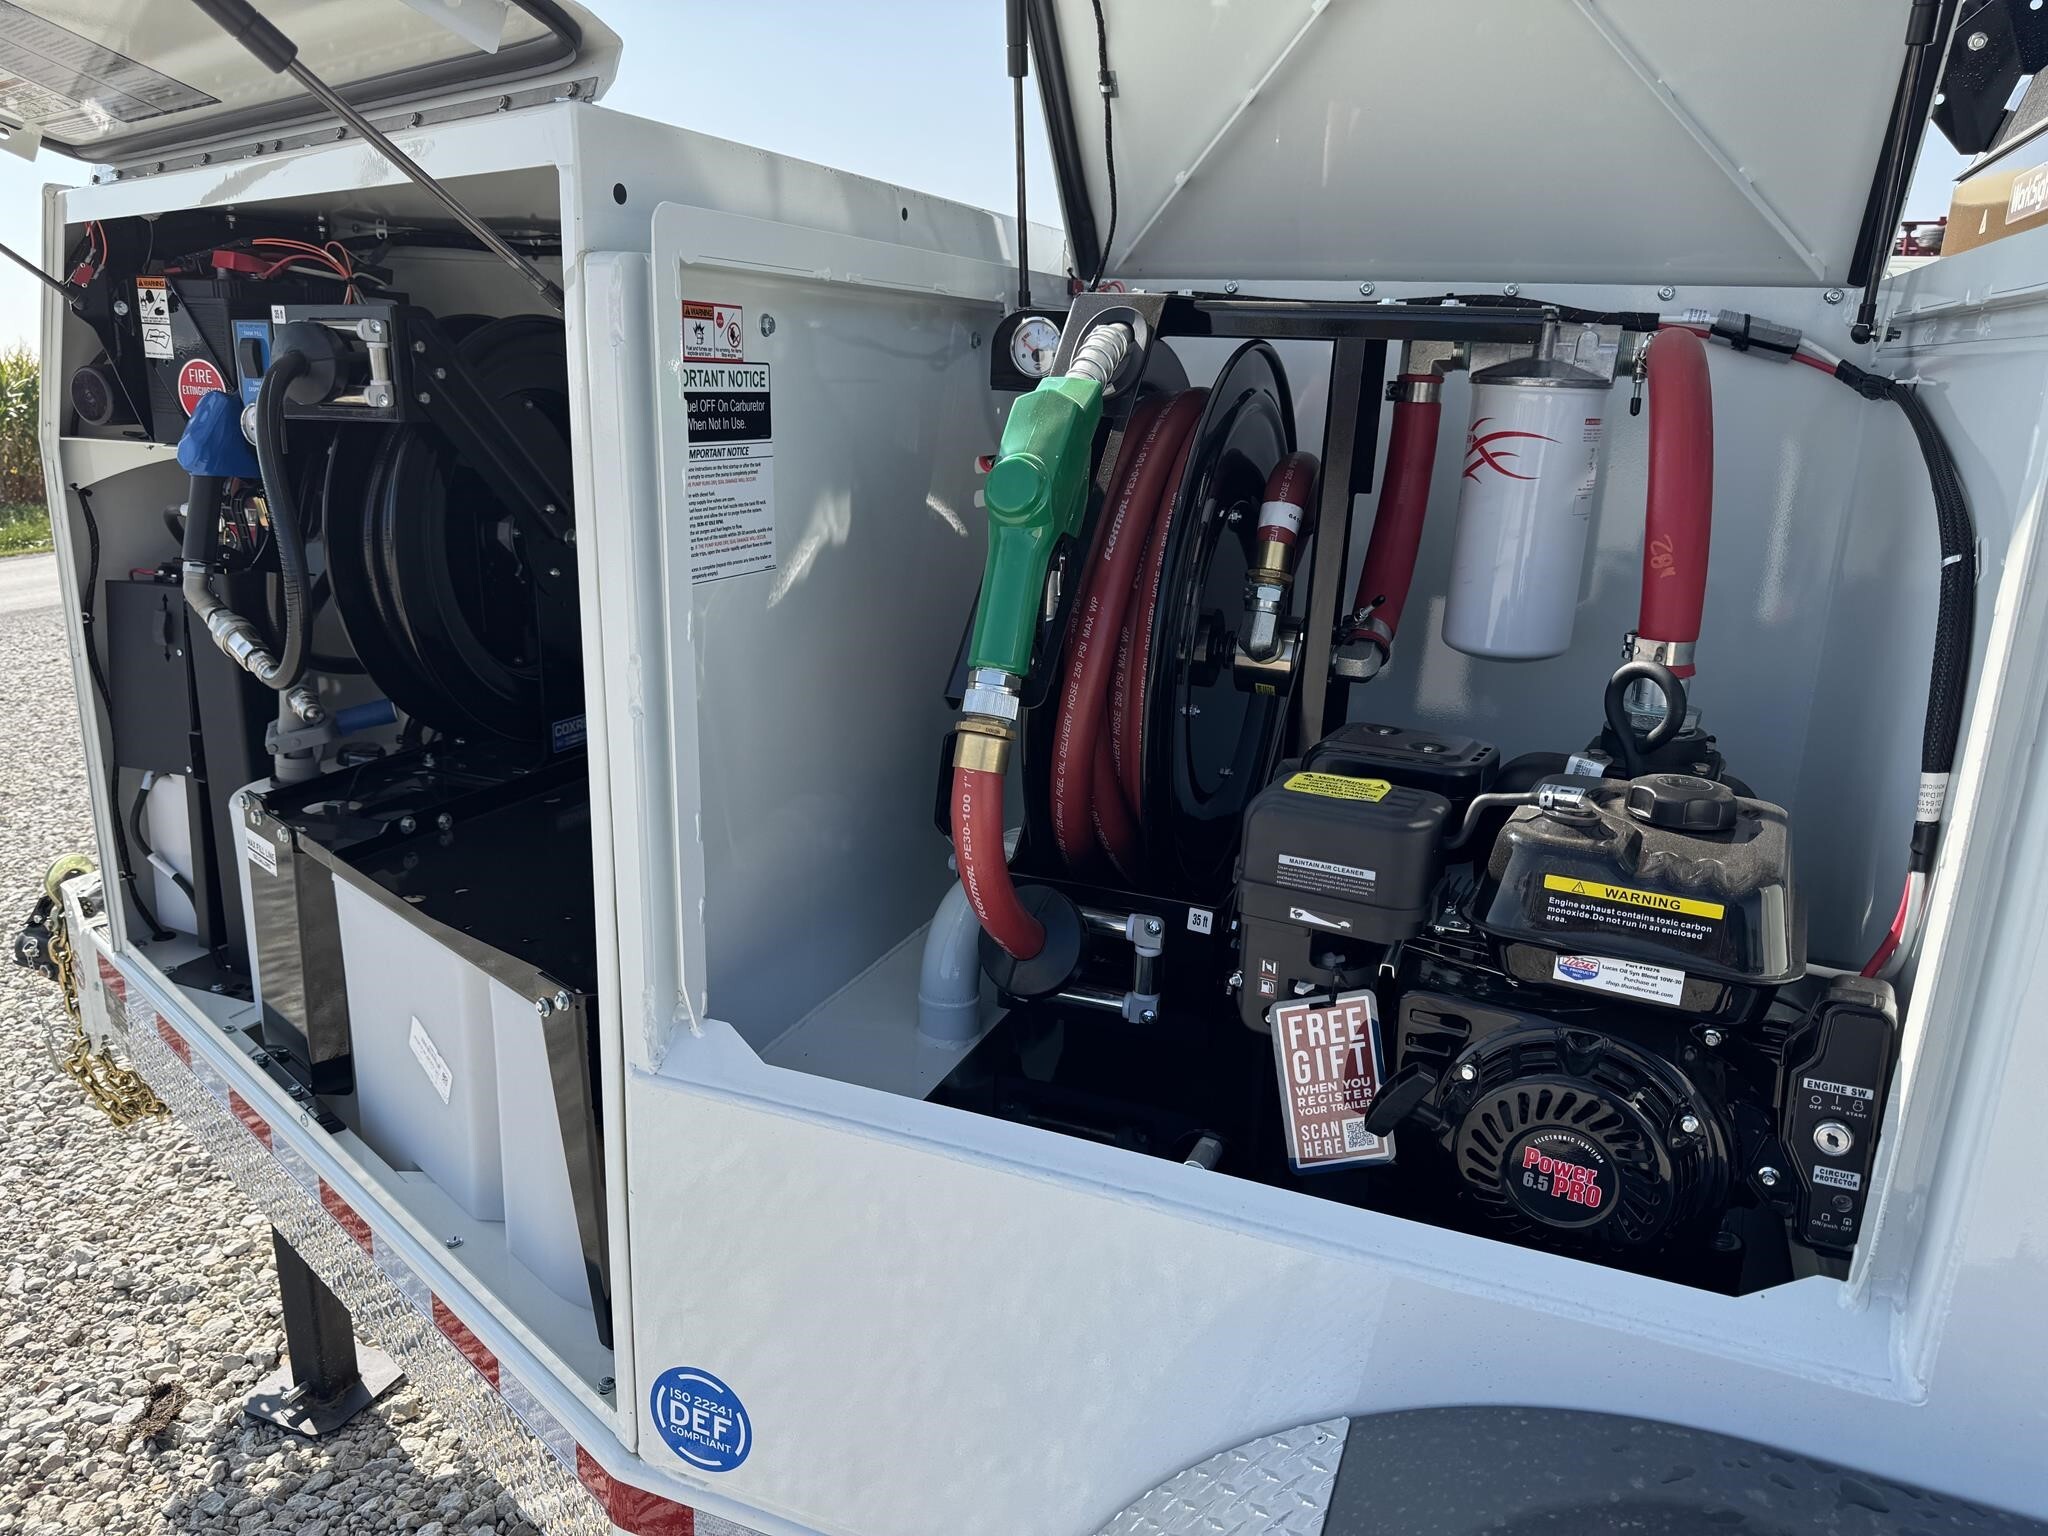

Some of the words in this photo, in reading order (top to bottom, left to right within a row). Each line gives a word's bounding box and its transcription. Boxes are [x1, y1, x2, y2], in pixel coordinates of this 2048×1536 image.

[144, 279, 165, 288] WARNING
[189, 368, 213, 384] FIRE
[684, 369, 725, 388] ORTANT
[728, 370, 766, 388] NOTICE
[688, 400, 698, 412] uel
[700, 400, 716, 412] OFF
[717, 400, 729, 412] On
[730, 400, 766, 412] Carburetor
[708, 417, 722, 430] Not
[723, 417, 730, 430] In
[731, 417, 747, 430] Use.
[689, 448, 726, 459] MPORTANT
[727, 446, 750, 457] NOTICE
[1089, 595, 1100, 613] WP
[1082, 615, 1095, 640] MAX
[1121, 625, 1130, 643] WP
[1077, 640, 1088, 659] PSI
[1118, 644, 1128, 669] MAX
[1073, 659, 1083, 679] 250
[1067, 680, 1079, 710] HOSE
[1112, 703, 1121, 734] HOSE
[1060, 712, 1073, 758] DELIVERY
[1057, 760, 1067, 776] OIL
[1055, 777, 1065, 798] FUEL
[1319, 775, 1372, 787] WARNING
[963, 794, 972, 860] PE30-100
[1288, 858, 1319, 869] MAINTAIN
[1320, 864, 1332, 872] AIR
[1332, 866, 1365, 877] CLEANER
[1604, 887, 1681, 911] WARNING
[1192, 913, 1201, 926] 35
[1202, 915, 1209, 928] ft
[1546, 914, 1568, 924] area.
[1548, 897, 1579, 909] Engine
[1580, 903, 1615, 916] exhaust
[1616, 909, 1655, 922] contains
[1656, 916, 1679, 927] toxic
[1680, 920, 1713, 933] carbon
[1606, 917, 1621, 926] not
[1621, 920, 1637, 929] run
[1638, 921, 1647, 929] in
[1648, 924, 1660, 932] an
[1661, 926, 1703, 940] enclosed
[1563, 956, 1597, 970] LUCAS
[1602, 964, 1618, 972] Lucas
[1641, 972, 1659, 980] Blend
[1625, 962, 1638, 970] Part
[1605, 980, 1674, 998] shop.thundercreek.com
[1624, 977, 1650, 987] Purchase
[1288, 1006, 1365, 1050] FREE
[1292, 1042, 1366, 1084] GIFT
[1295, 1080, 1338, 1096] WHEN
[1342, 1076, 1371, 1090] YOU
[1807, 1080, 1847, 1094] ENGINE
[1297, 1088, 1373, 1107] REGISTER
[1298, 1105, 1328, 1117] YOUR
[1845, 1111, 1867, 1119] START
[1301, 1120, 1341, 1141] SCAN
[1534, 1134, 1575, 1145] ELECTRONIC
[1303, 1138, 1343, 1158] HERE
[1522, 1145, 1598, 1186] Power
[1819, 1168, 1855, 1180] CIRCUIT
[1522, 1171, 1549, 1192] 6.5
[1551, 1174, 1602, 1208] PRO
[1814, 1173, 1858, 1188] PROTECTOR
[1840, 1225, 1852, 1233] OFF
[670, 1387, 691, 1403] ISO
[694, 1396, 732, 1418] 22241
[670, 1399, 732, 1440] DEF
[670, 1424, 732, 1454] COMPLIANT
